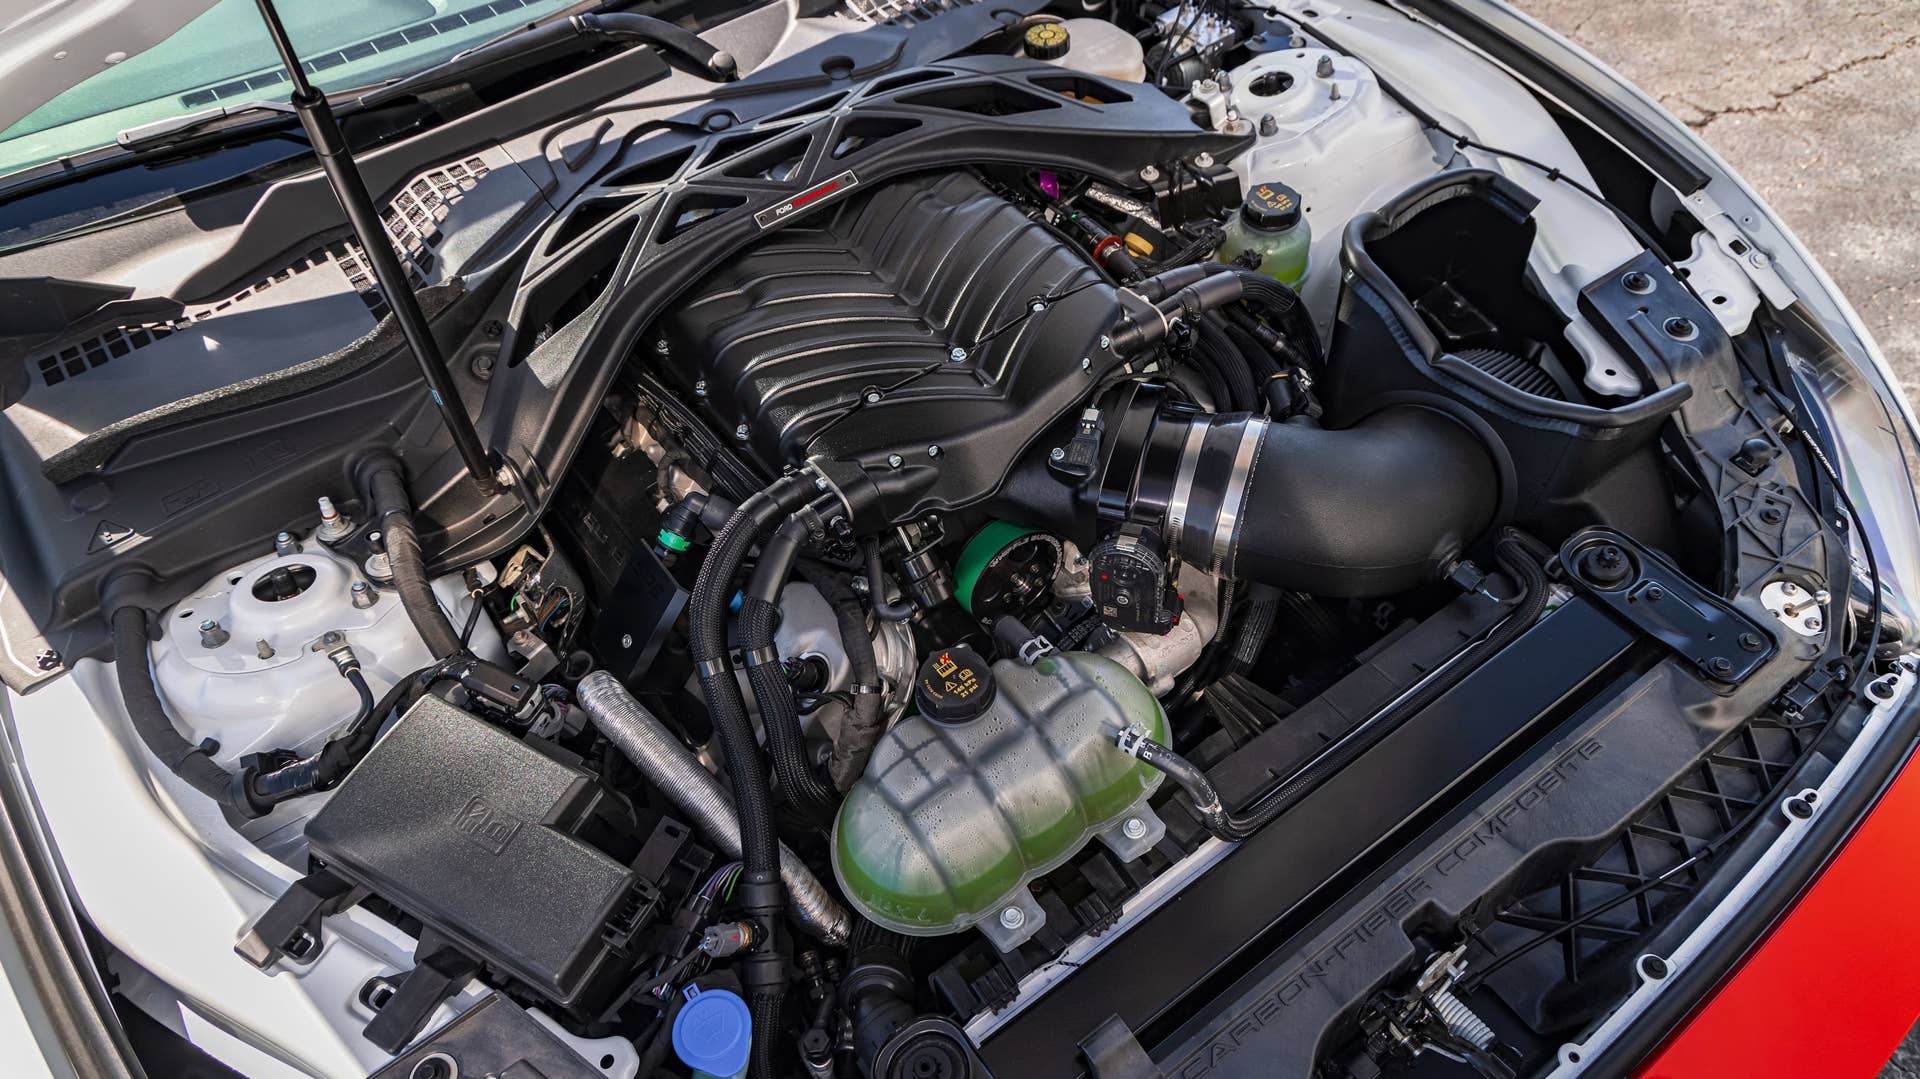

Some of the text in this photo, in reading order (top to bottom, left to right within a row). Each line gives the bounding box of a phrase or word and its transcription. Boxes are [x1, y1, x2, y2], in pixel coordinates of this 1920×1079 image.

[776, 203, 793, 216] FORD
[1180, 739, 1604, 1079] CARBON-FIBER COMPOSITE
